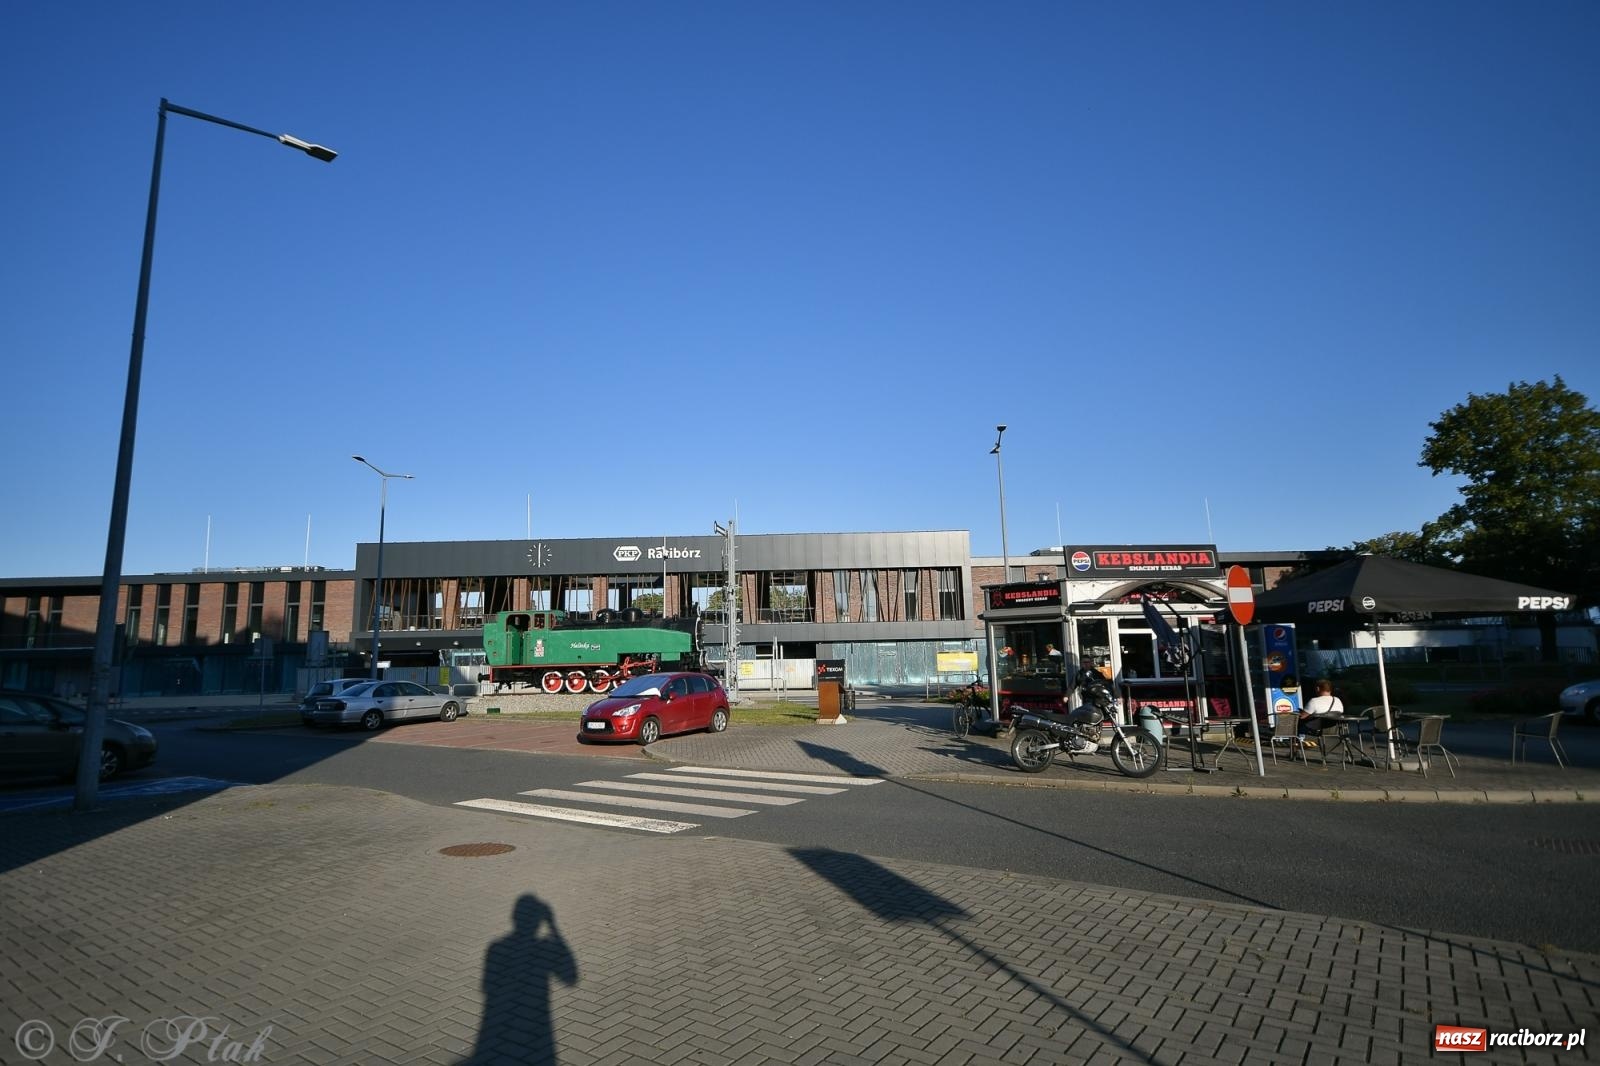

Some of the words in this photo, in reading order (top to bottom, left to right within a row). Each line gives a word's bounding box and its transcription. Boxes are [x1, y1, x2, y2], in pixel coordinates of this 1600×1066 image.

[648, 547, 701, 559] Raibórz
[1097, 553, 1211, 565] KEBSLANDIA
[1005, 589, 1058, 600] KEBSLANDIA
[1308, 600, 1344, 613] PEPSI
[1518, 597, 1570, 610] PEPSI
